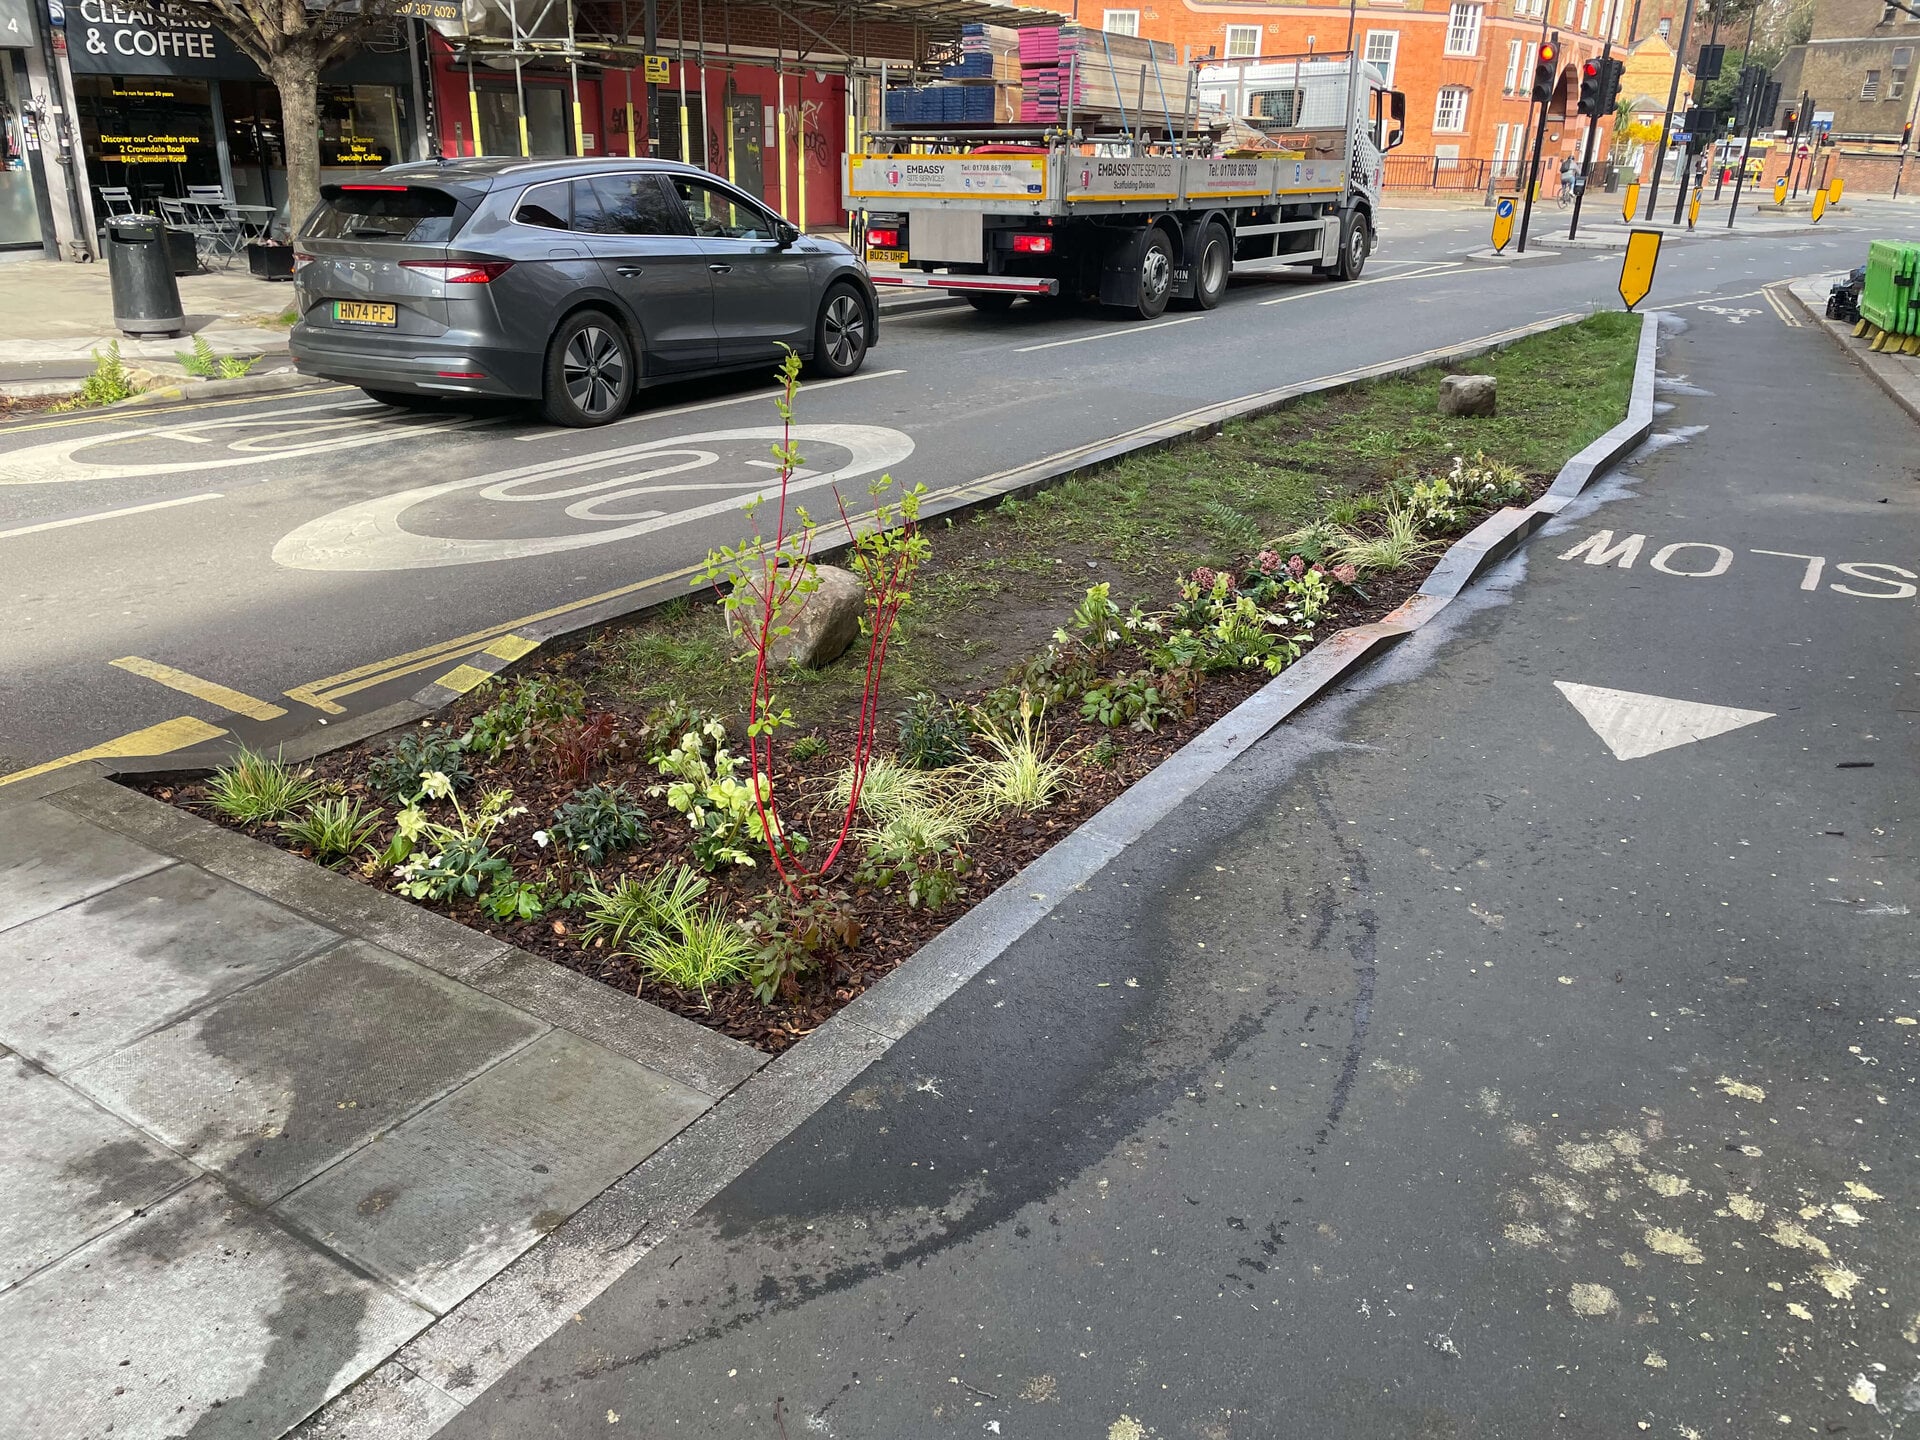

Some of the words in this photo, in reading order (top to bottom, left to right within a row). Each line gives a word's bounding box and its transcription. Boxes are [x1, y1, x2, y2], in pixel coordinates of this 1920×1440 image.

[396, 2, 413, 14] 07
[415, 3, 432, 16] 387
[434, 6, 456, 18] 6029
[8, 18, 18, 33] 4
[86, 28, 108, 54] &
[114, 29, 217, 58] COFFEE
[101, 135, 132, 143] Discover
[147, 135, 178, 143] Camden
[341, 136, 351, 144] Dry
[120, 145, 125, 153] 2
[127, 145, 166, 153] Crowndale
[167, 145, 185, 153] Road
[138, 155, 168, 163] Camden
[169, 155, 188, 163] Road
[337, 154, 362, 162] Specialty
[906, 165, 945, 174] EMBASSY
[1098, 164, 1130, 177] EMBASSY
[1131, 164, 1144, 177] SITE
[1145, 164, 1171, 177] SERVICES
[1209, 163, 1219, 176] Tel:
[1220, 163, 1237, 176] 01708
[1113, 181, 1138, 191] Scaffolding
[1139, 181, 1155, 189] Division
[869, 250, 889, 260] BU25
[890, 251, 905, 261] UHF
[341, 303, 369, 319] HN74
[372, 306, 395, 321] PFJ
[1557, 529, 1919, 600] SLOW
